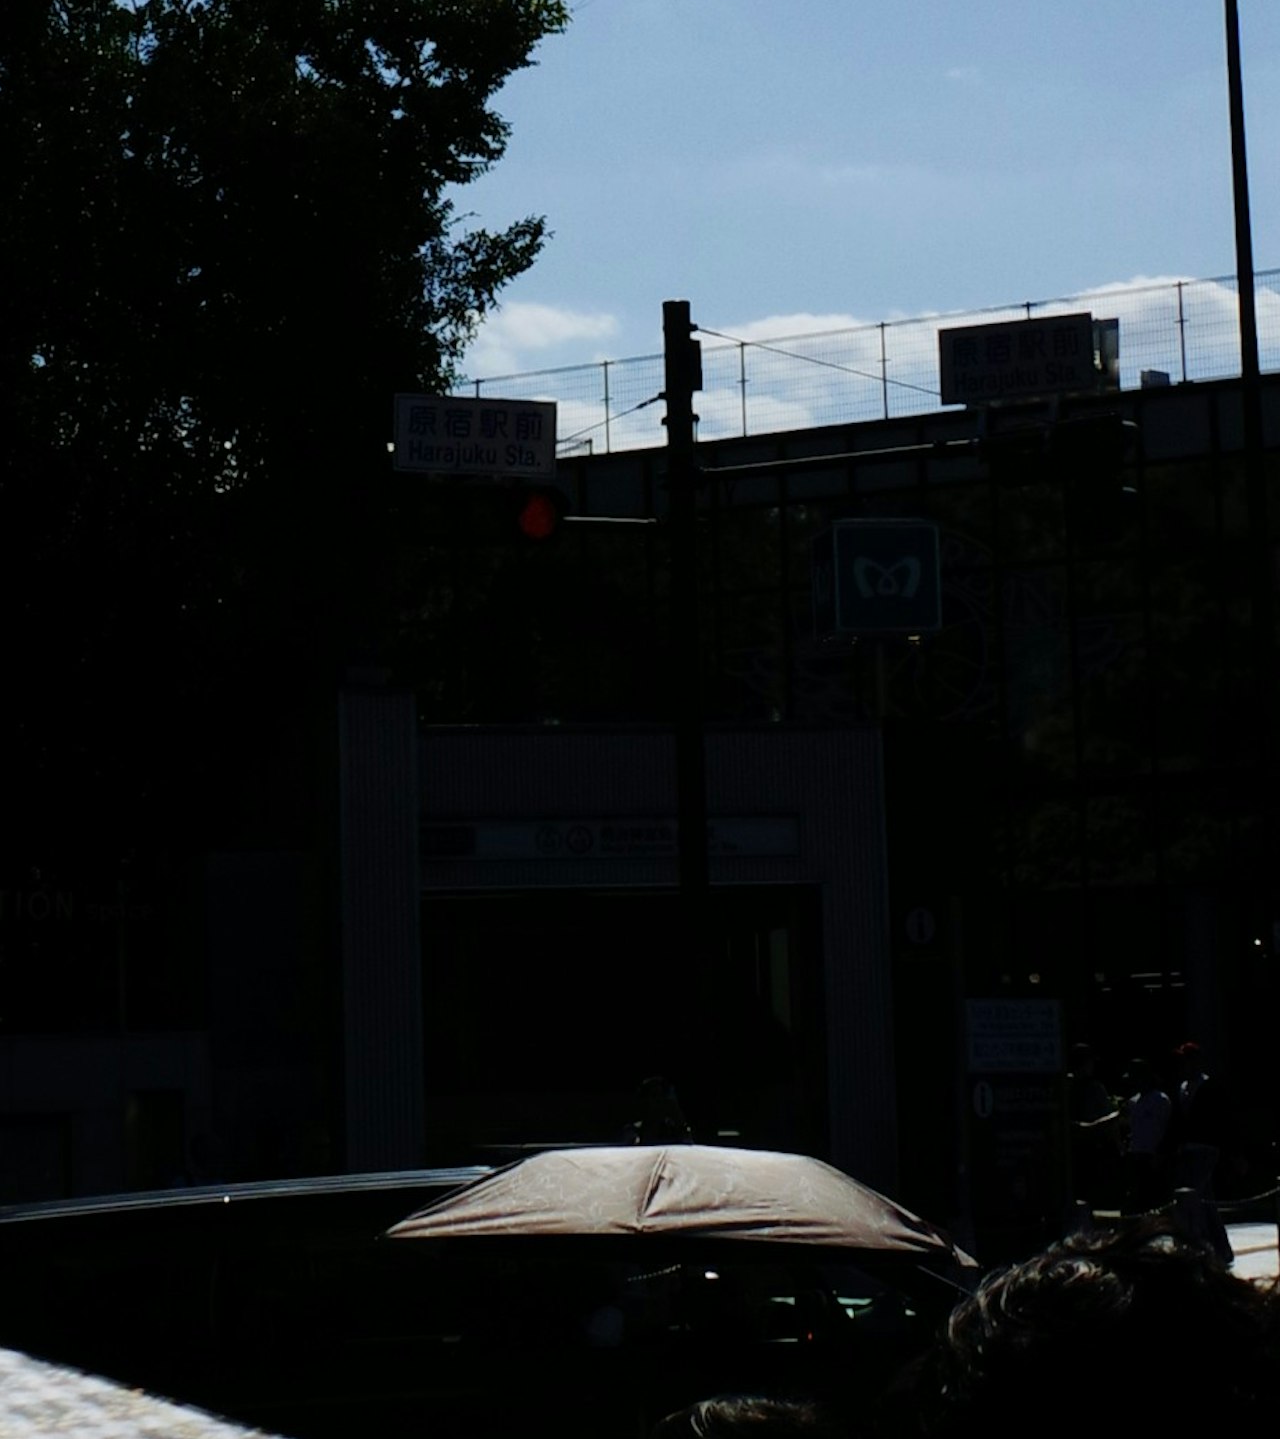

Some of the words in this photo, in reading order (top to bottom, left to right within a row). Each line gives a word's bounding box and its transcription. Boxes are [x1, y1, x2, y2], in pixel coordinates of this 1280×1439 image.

[953, 327, 1079, 367] 原宿駅前
[954, 368, 1038, 393] Harajuku
[409, 406, 543, 440] 原宿駅前
[409, 440, 497, 466] Harajuku
[505, 445, 541, 466] Sta.
